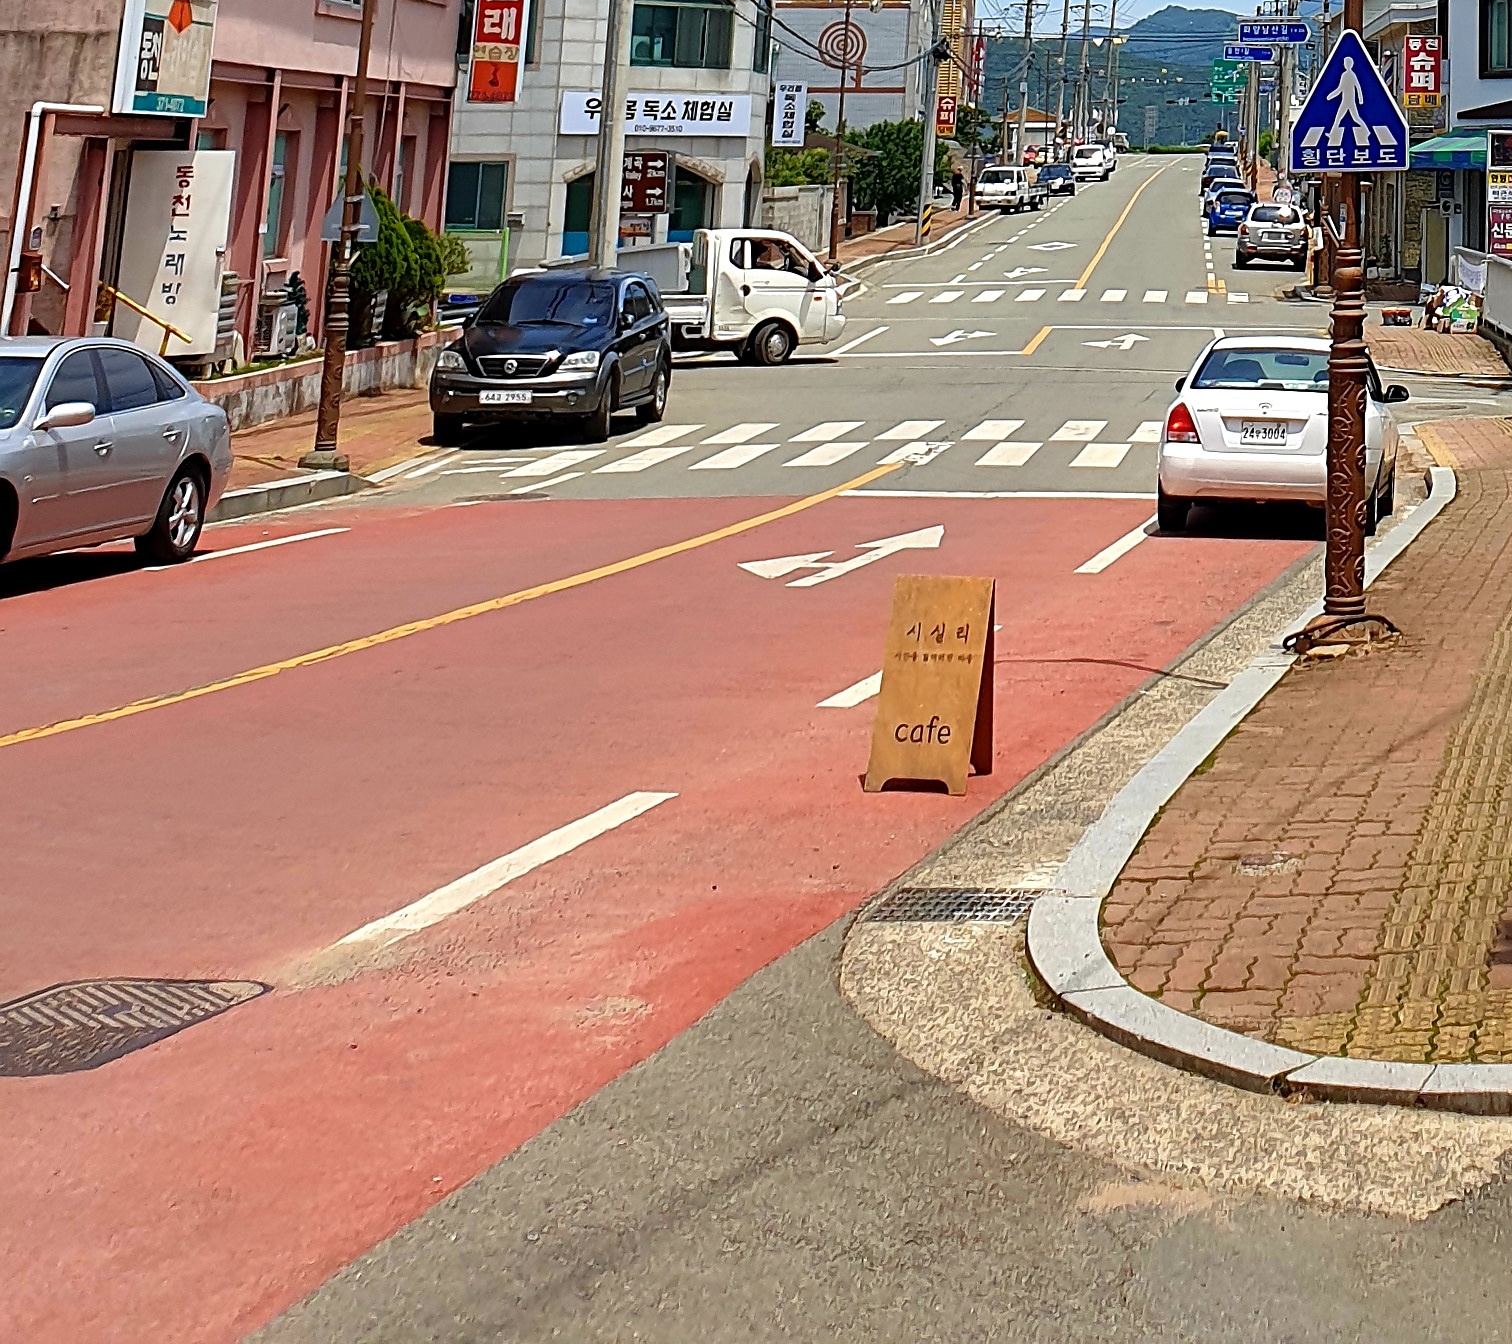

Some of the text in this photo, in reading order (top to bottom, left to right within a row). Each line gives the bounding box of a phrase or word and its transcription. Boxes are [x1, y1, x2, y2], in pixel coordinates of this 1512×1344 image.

[1410, 52, 1435, 91] 슈퍼
[643, 99, 677, 121] 독소
[682, 99, 734, 121] 체험실
[1301, 147, 1398, 166] 횡단보도
[894, 715, 951, 745] cafe
